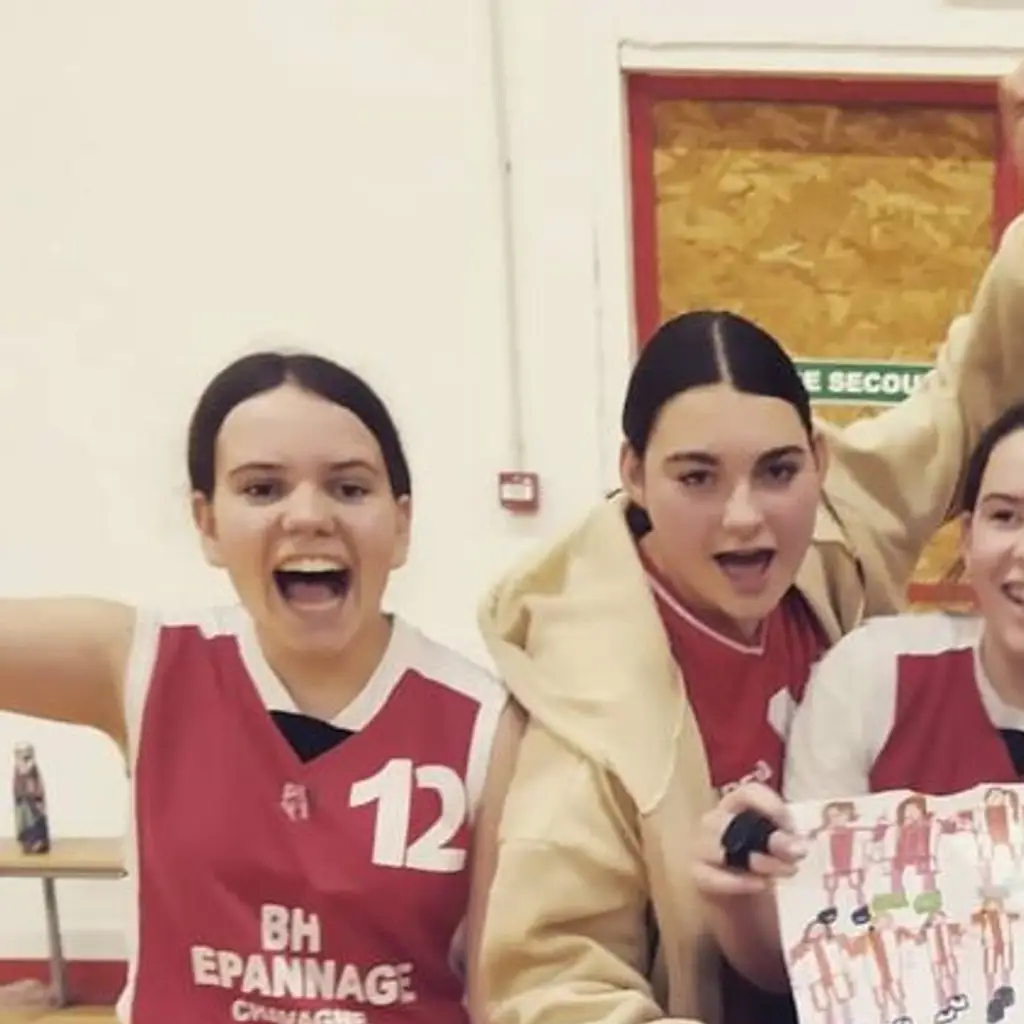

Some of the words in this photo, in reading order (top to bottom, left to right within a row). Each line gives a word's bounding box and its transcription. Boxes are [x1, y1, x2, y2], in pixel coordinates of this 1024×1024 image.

[829, 371, 920, 394] SECOU
[349, 757, 468, 873] 12
[261, 903, 321, 954] BH
